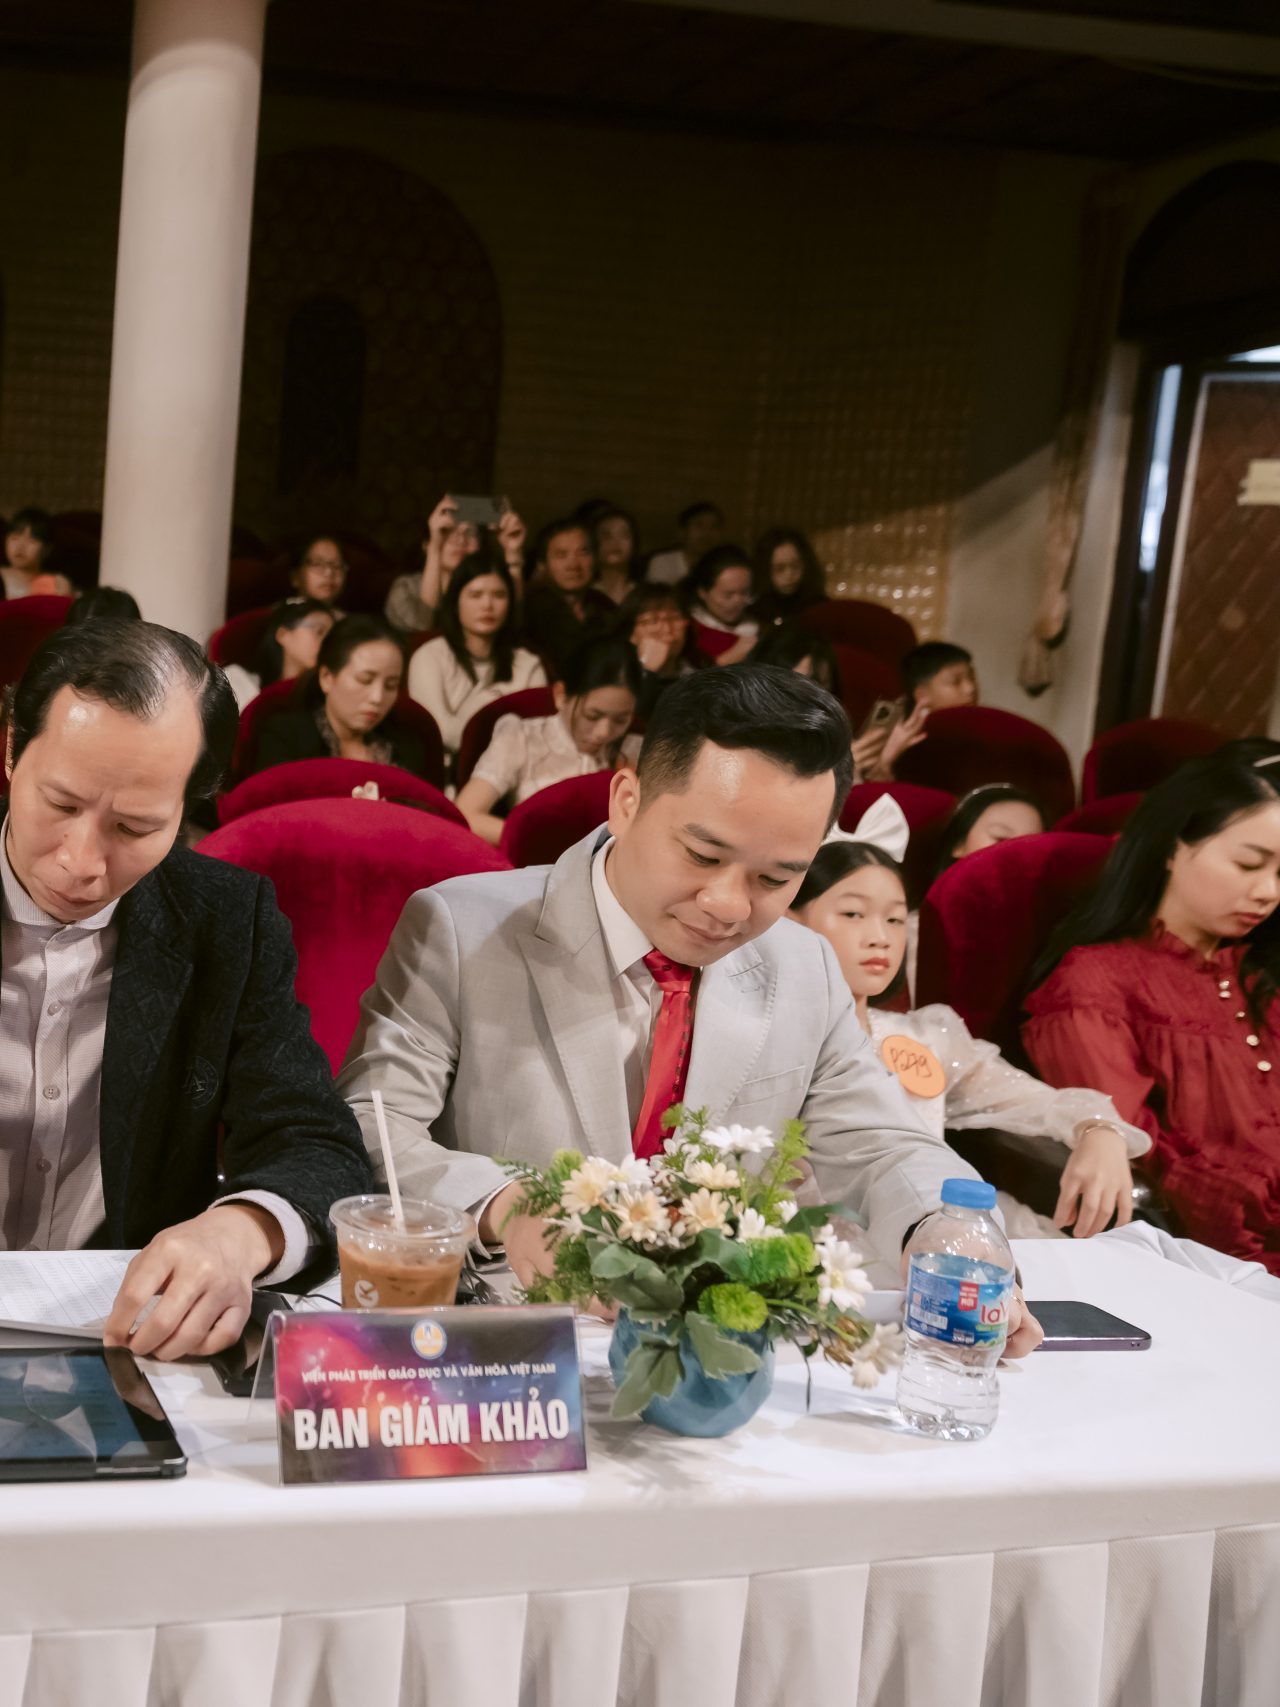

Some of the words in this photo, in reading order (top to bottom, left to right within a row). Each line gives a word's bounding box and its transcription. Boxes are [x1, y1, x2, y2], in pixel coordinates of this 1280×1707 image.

[302, 1365, 326, 1384] VIỆN
[328, 1367, 356, 1383] PHÁT
[388, 1366, 417, 1380] GIÁO
[418, 1367, 441, 1380] DỤC
[443, 1364, 459, 1377] VÀ
[460, 1363, 483, 1377] VĂN
[484, 1362, 508, 1376] HÓA
[509, 1361, 532, 1377] VIỆT
[532, 1362, 556, 1375] NAM
[293, 1407, 370, 1450] BAN
[379, 1396, 470, 1447] GIÁM
[479, 1387, 569, 1443] KHẢO
